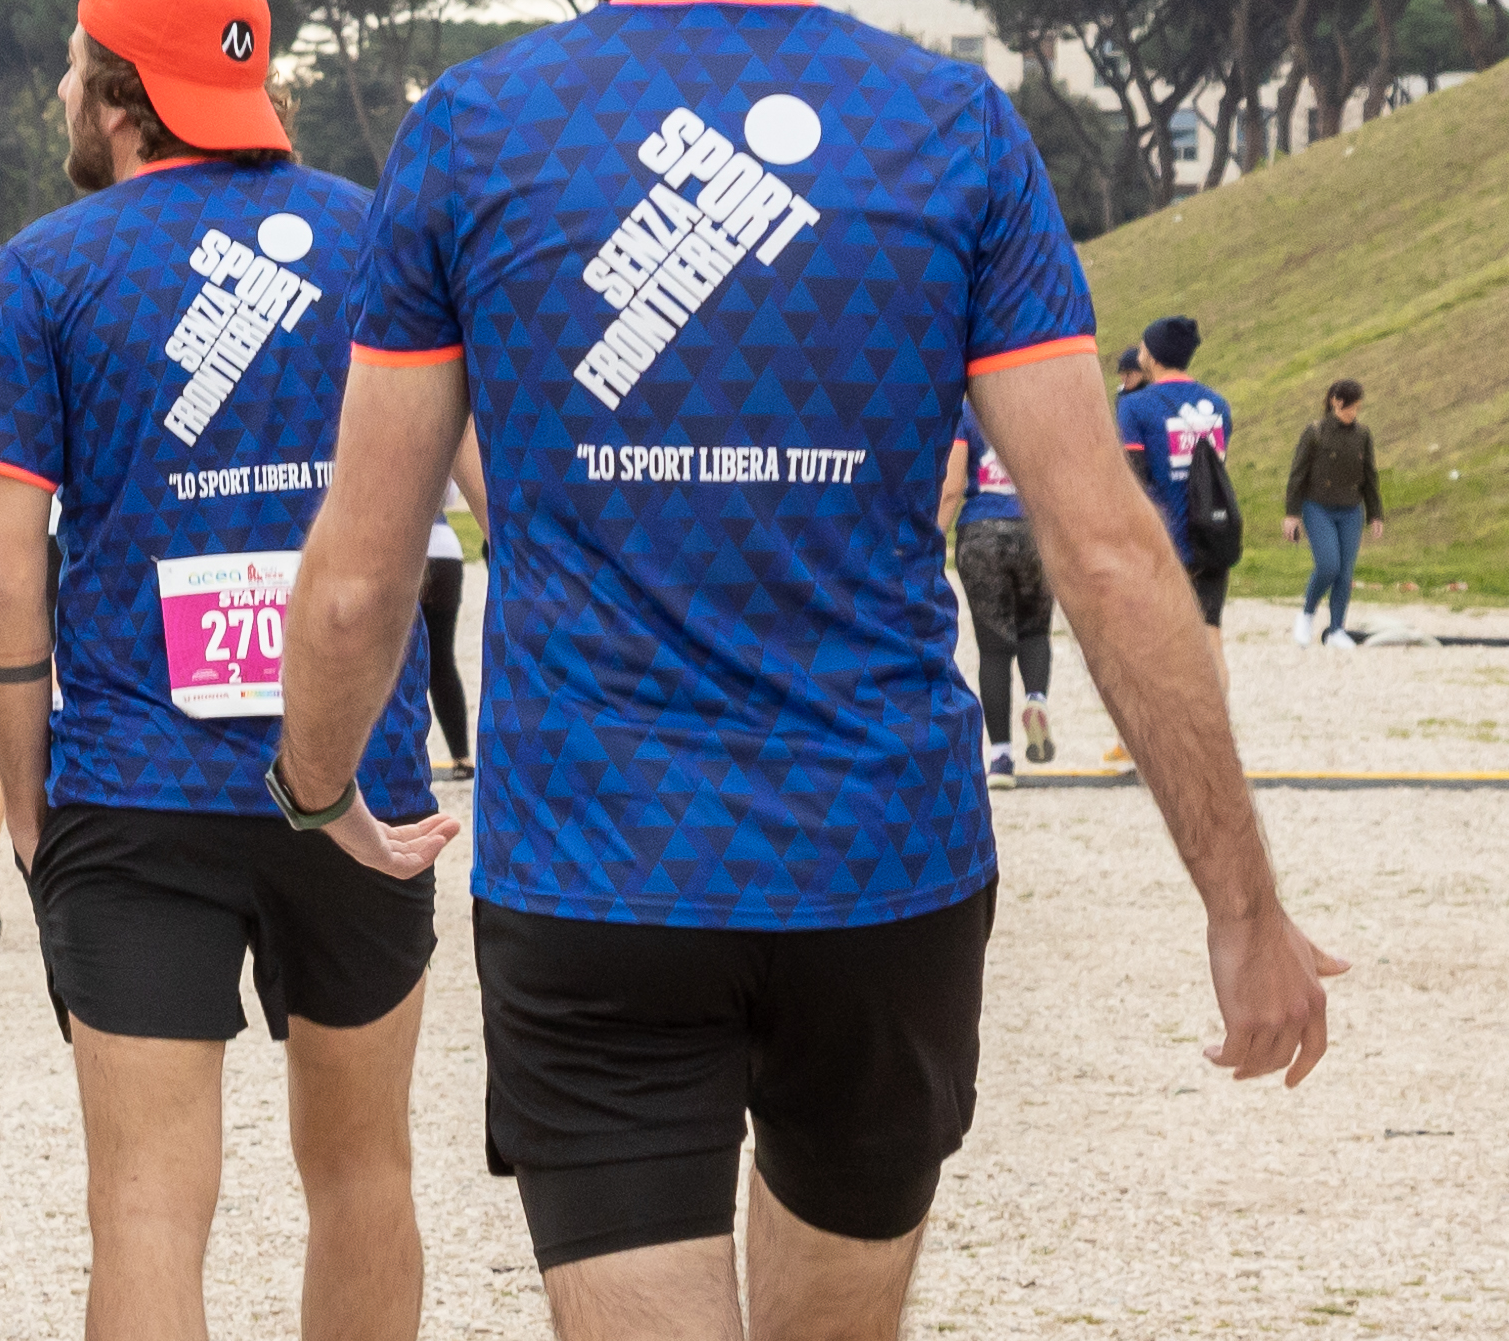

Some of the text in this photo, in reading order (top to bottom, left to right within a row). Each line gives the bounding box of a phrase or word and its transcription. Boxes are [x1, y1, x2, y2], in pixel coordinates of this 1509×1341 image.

[638, 107, 820, 266] SPORT
[189, 229, 322, 333] SPORT
[583, 183, 704, 310] SENZA
[165, 281, 242, 374] SENZA
[573, 215, 748, 411] FRONTIERE
[164, 302, 276, 447] FRONTIERE
[199, 466, 251, 498] SPORT
[254, 462, 312, 493] LIBERA
[620, 446, 695, 481] SPORT
[699, 447, 780, 482] LIBERA
[201, 607, 284, 661] 270
[218, 589, 292, 608] STAFFE
[227, 663, 242, 684] 2
